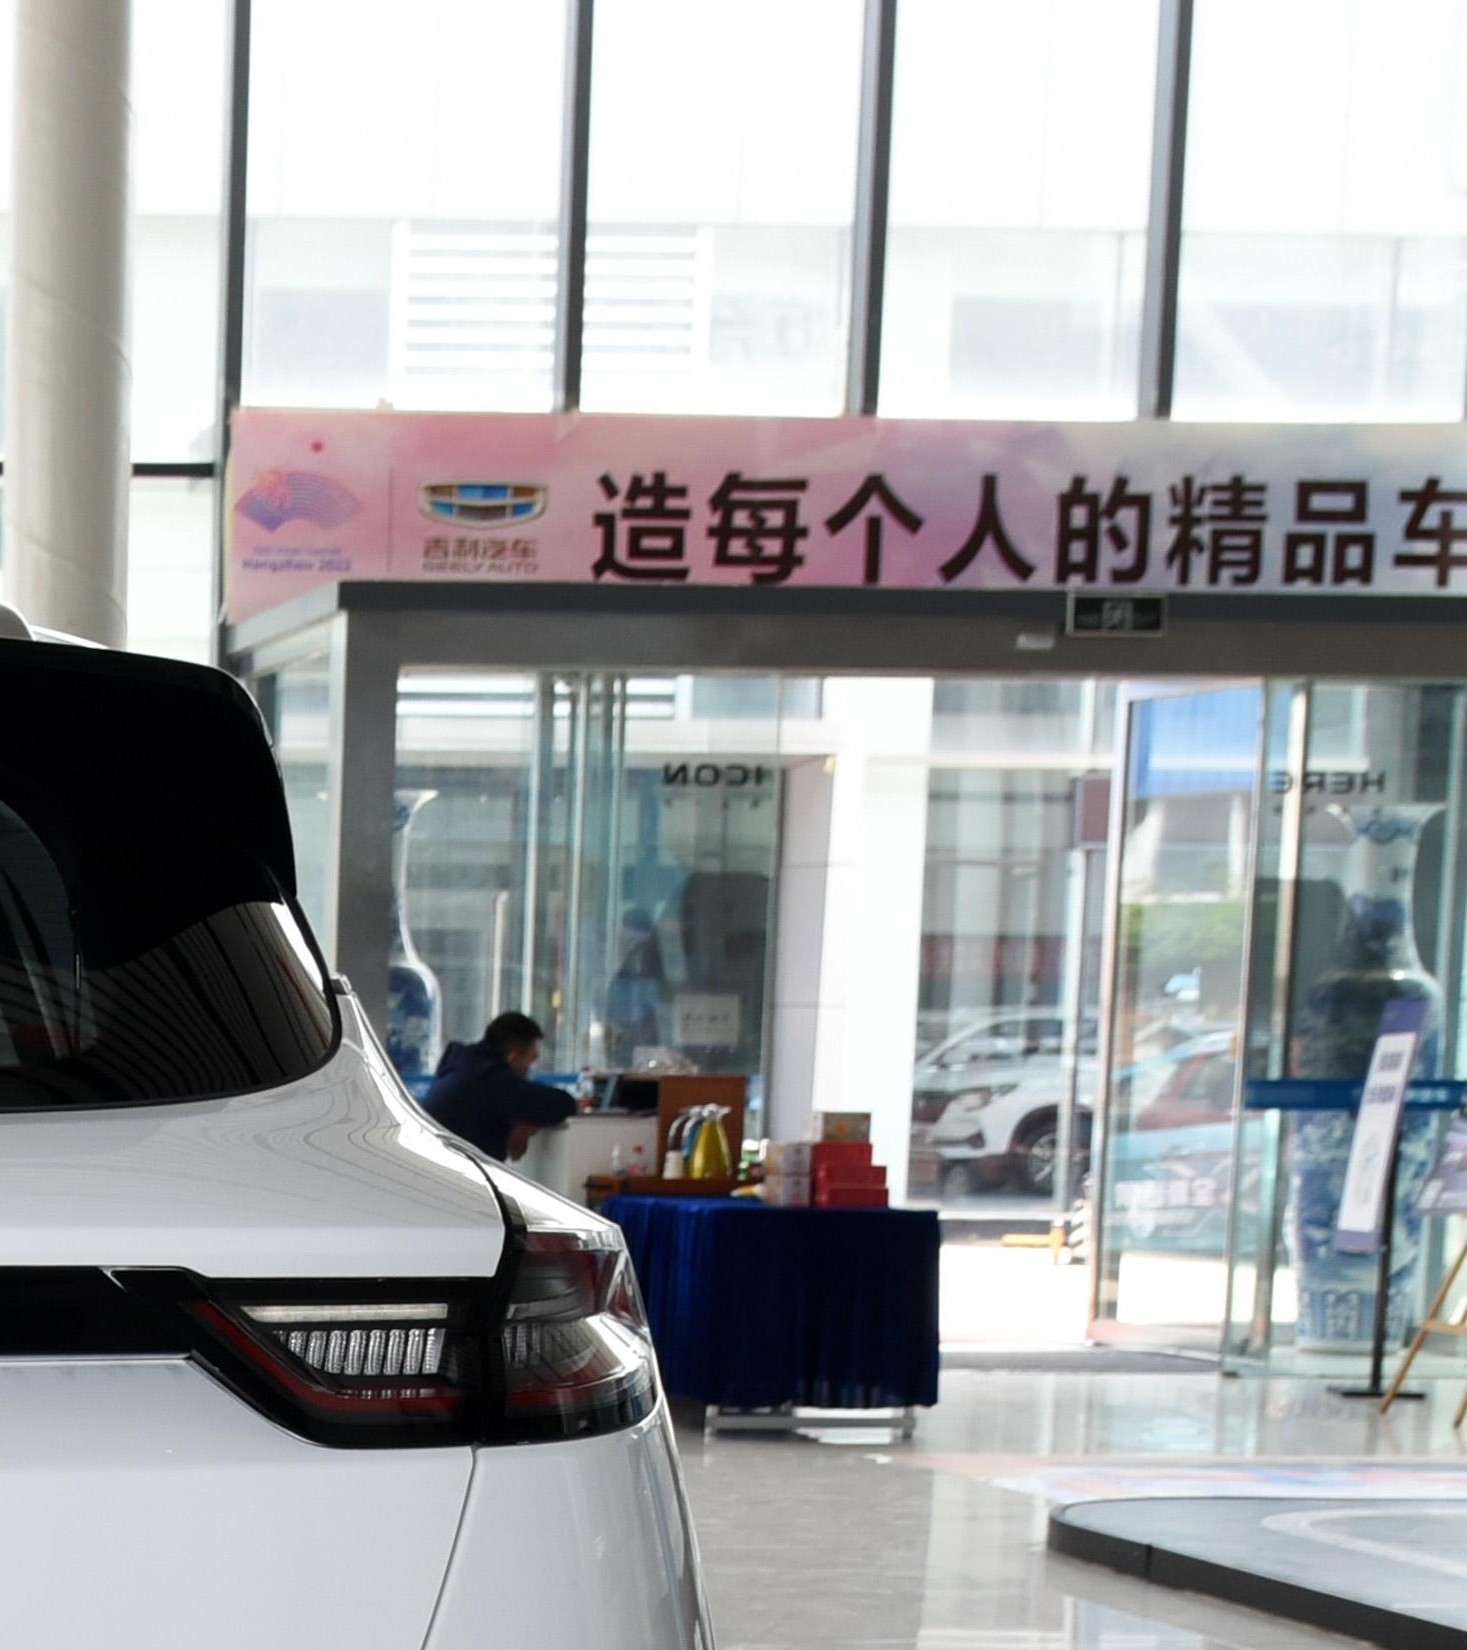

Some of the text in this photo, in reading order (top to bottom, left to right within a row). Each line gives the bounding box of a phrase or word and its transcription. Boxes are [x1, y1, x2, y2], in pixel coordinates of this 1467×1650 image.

[592, 471, 1467, 587] 造每个人的精品车
